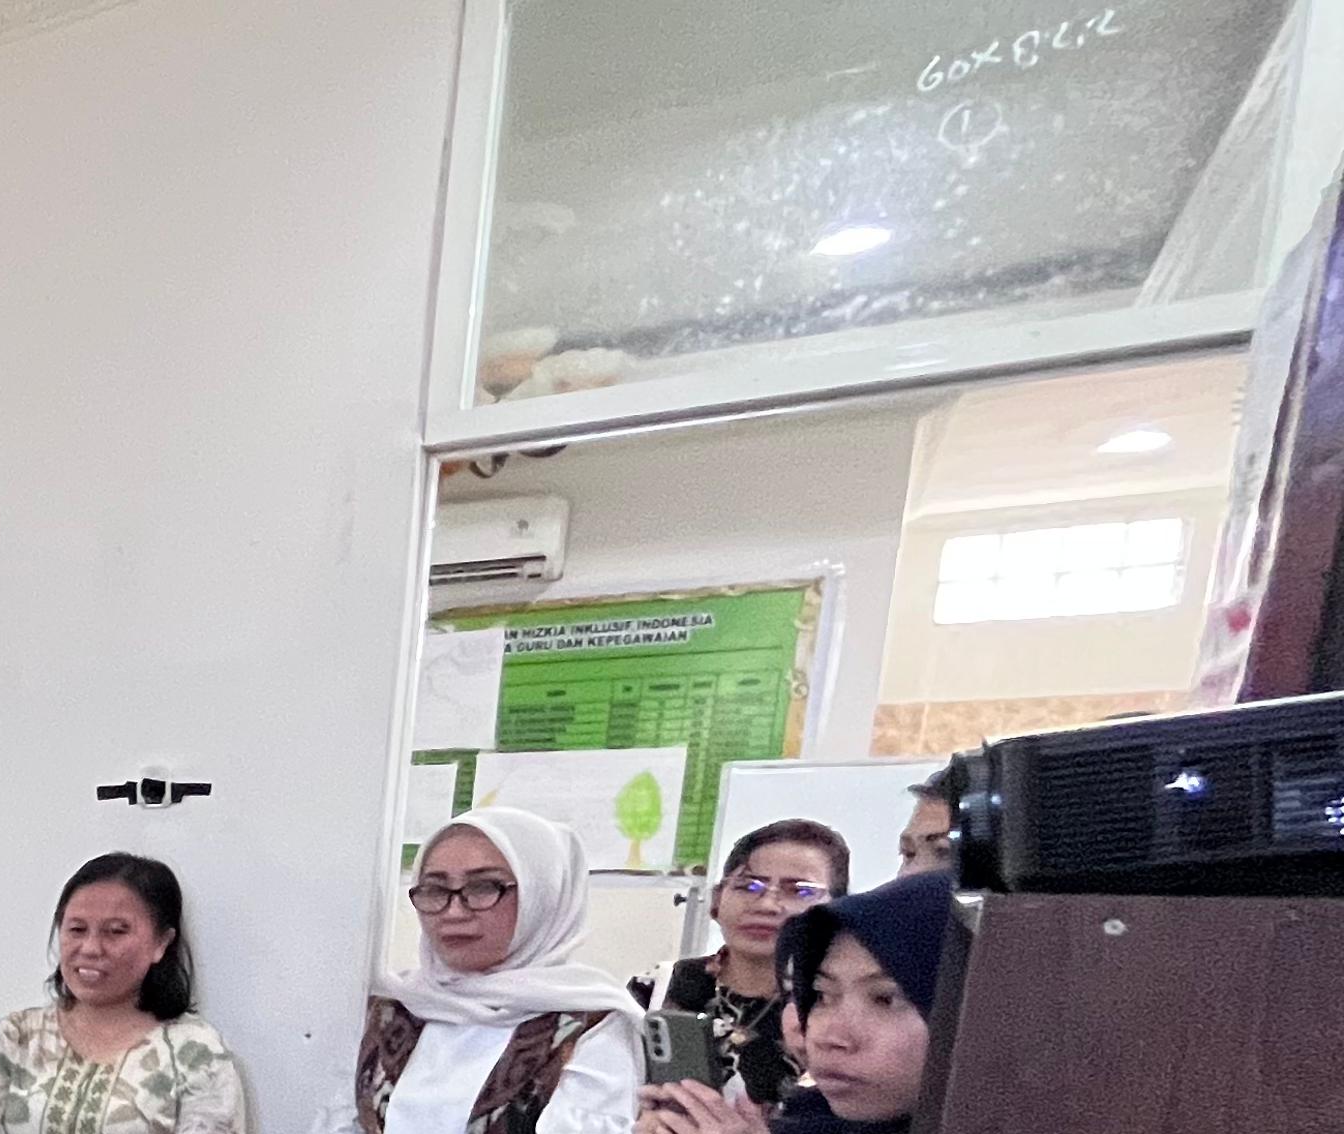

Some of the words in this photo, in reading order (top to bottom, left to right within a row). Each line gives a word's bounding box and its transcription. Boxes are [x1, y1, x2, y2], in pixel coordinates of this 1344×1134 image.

[522, 626, 566, 639] HIZKIA
[570, 619, 632, 635] INKLUSIF
[637, 614, 713, 630] INDONESIA
[516, 639, 553, 653] GURU
[557, 638, 583, 650] DAN
[588, 630, 688, 647] KEPEGAWAIAN
